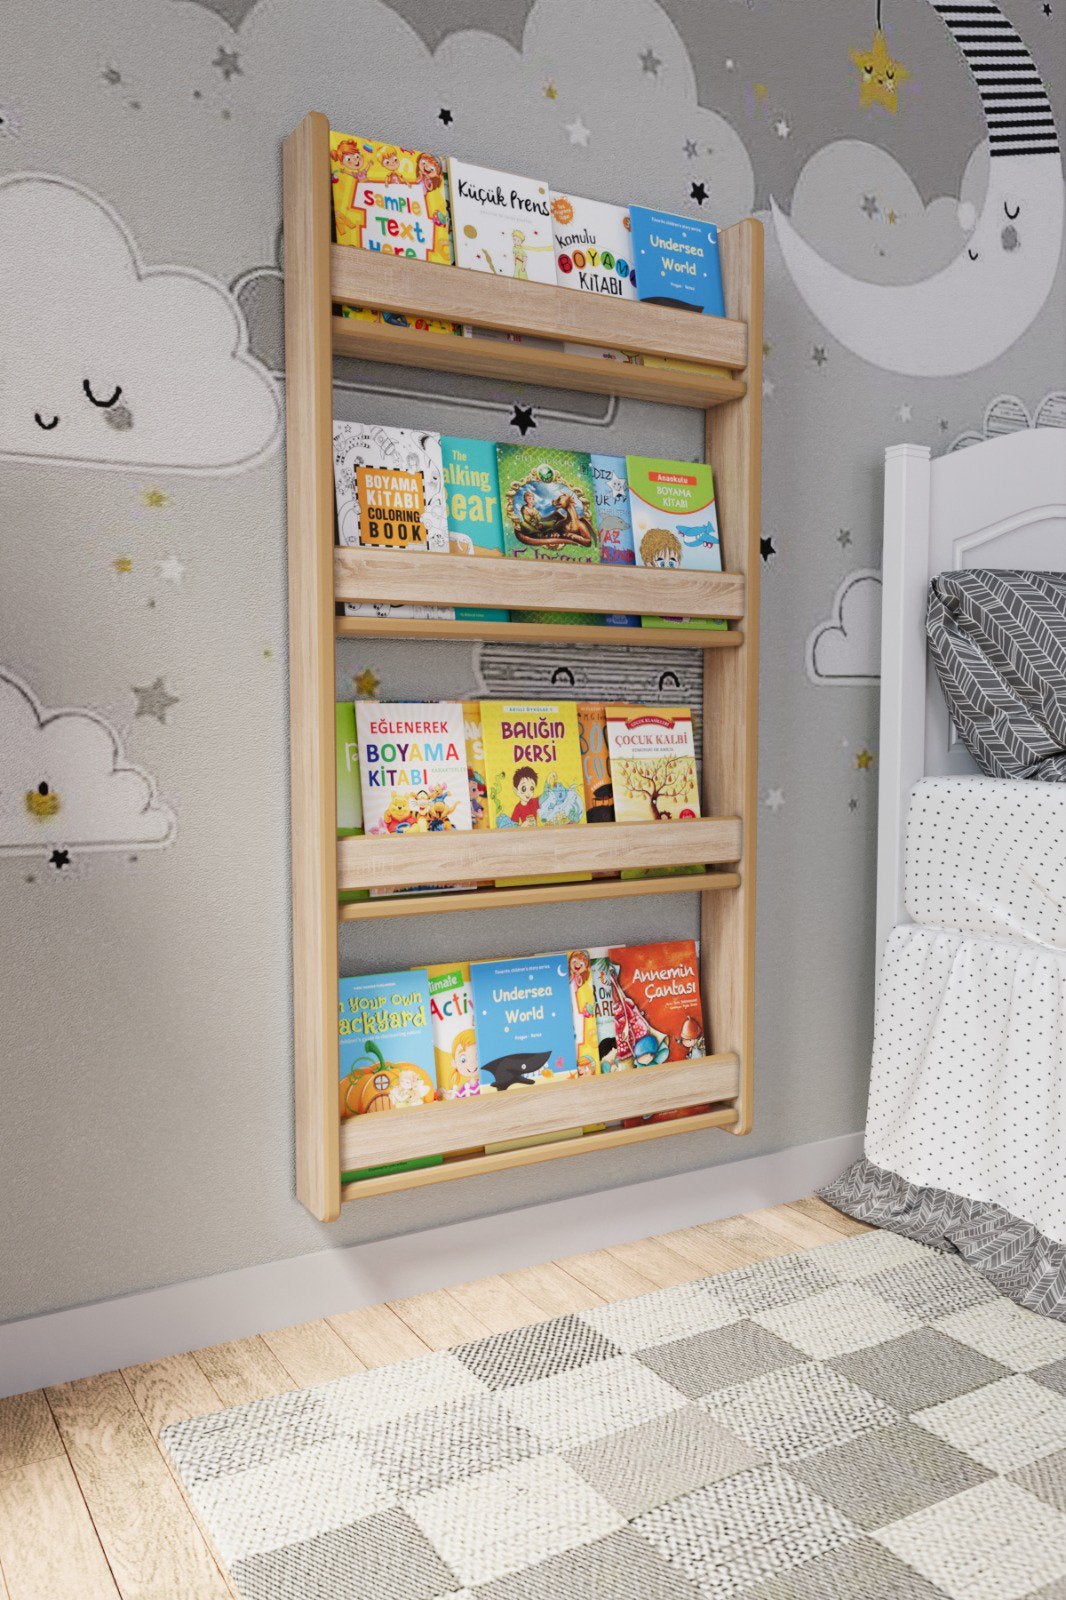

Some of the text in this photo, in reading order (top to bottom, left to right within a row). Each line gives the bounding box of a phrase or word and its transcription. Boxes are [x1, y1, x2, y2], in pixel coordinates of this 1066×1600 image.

[363, 189, 421, 216] Sample
[458, 178, 507, 207] Küçük
[510, 189, 550, 216] Prens
[374, 216, 426, 243] Text
[649, 233, 705, 258] Undersea
[660, 256, 697, 276] World
[578, 270, 623, 296] KİTABI
[451, 449, 467, 461] The
[365, 474, 419, 493] BOYAMA
[366, 489, 420, 510] KİTABI
[444, 487, 497, 523] ear
[367, 507, 421, 523] COLORING
[369, 521, 422, 541] BOOK
[370, 718, 449, 735] EĞLENEREK
[614, 732, 688, 747] ÇOCUK KALBİ
[365, 743, 460, 763] BOYAMA
[368, 765, 428, 787] KİTABI
[632, 963, 695, 984] Annemin
[492, 986, 553, 1003] Undersea
[645, 981, 696, 1003] Çantası
[505, 1005, 544, 1024] World
